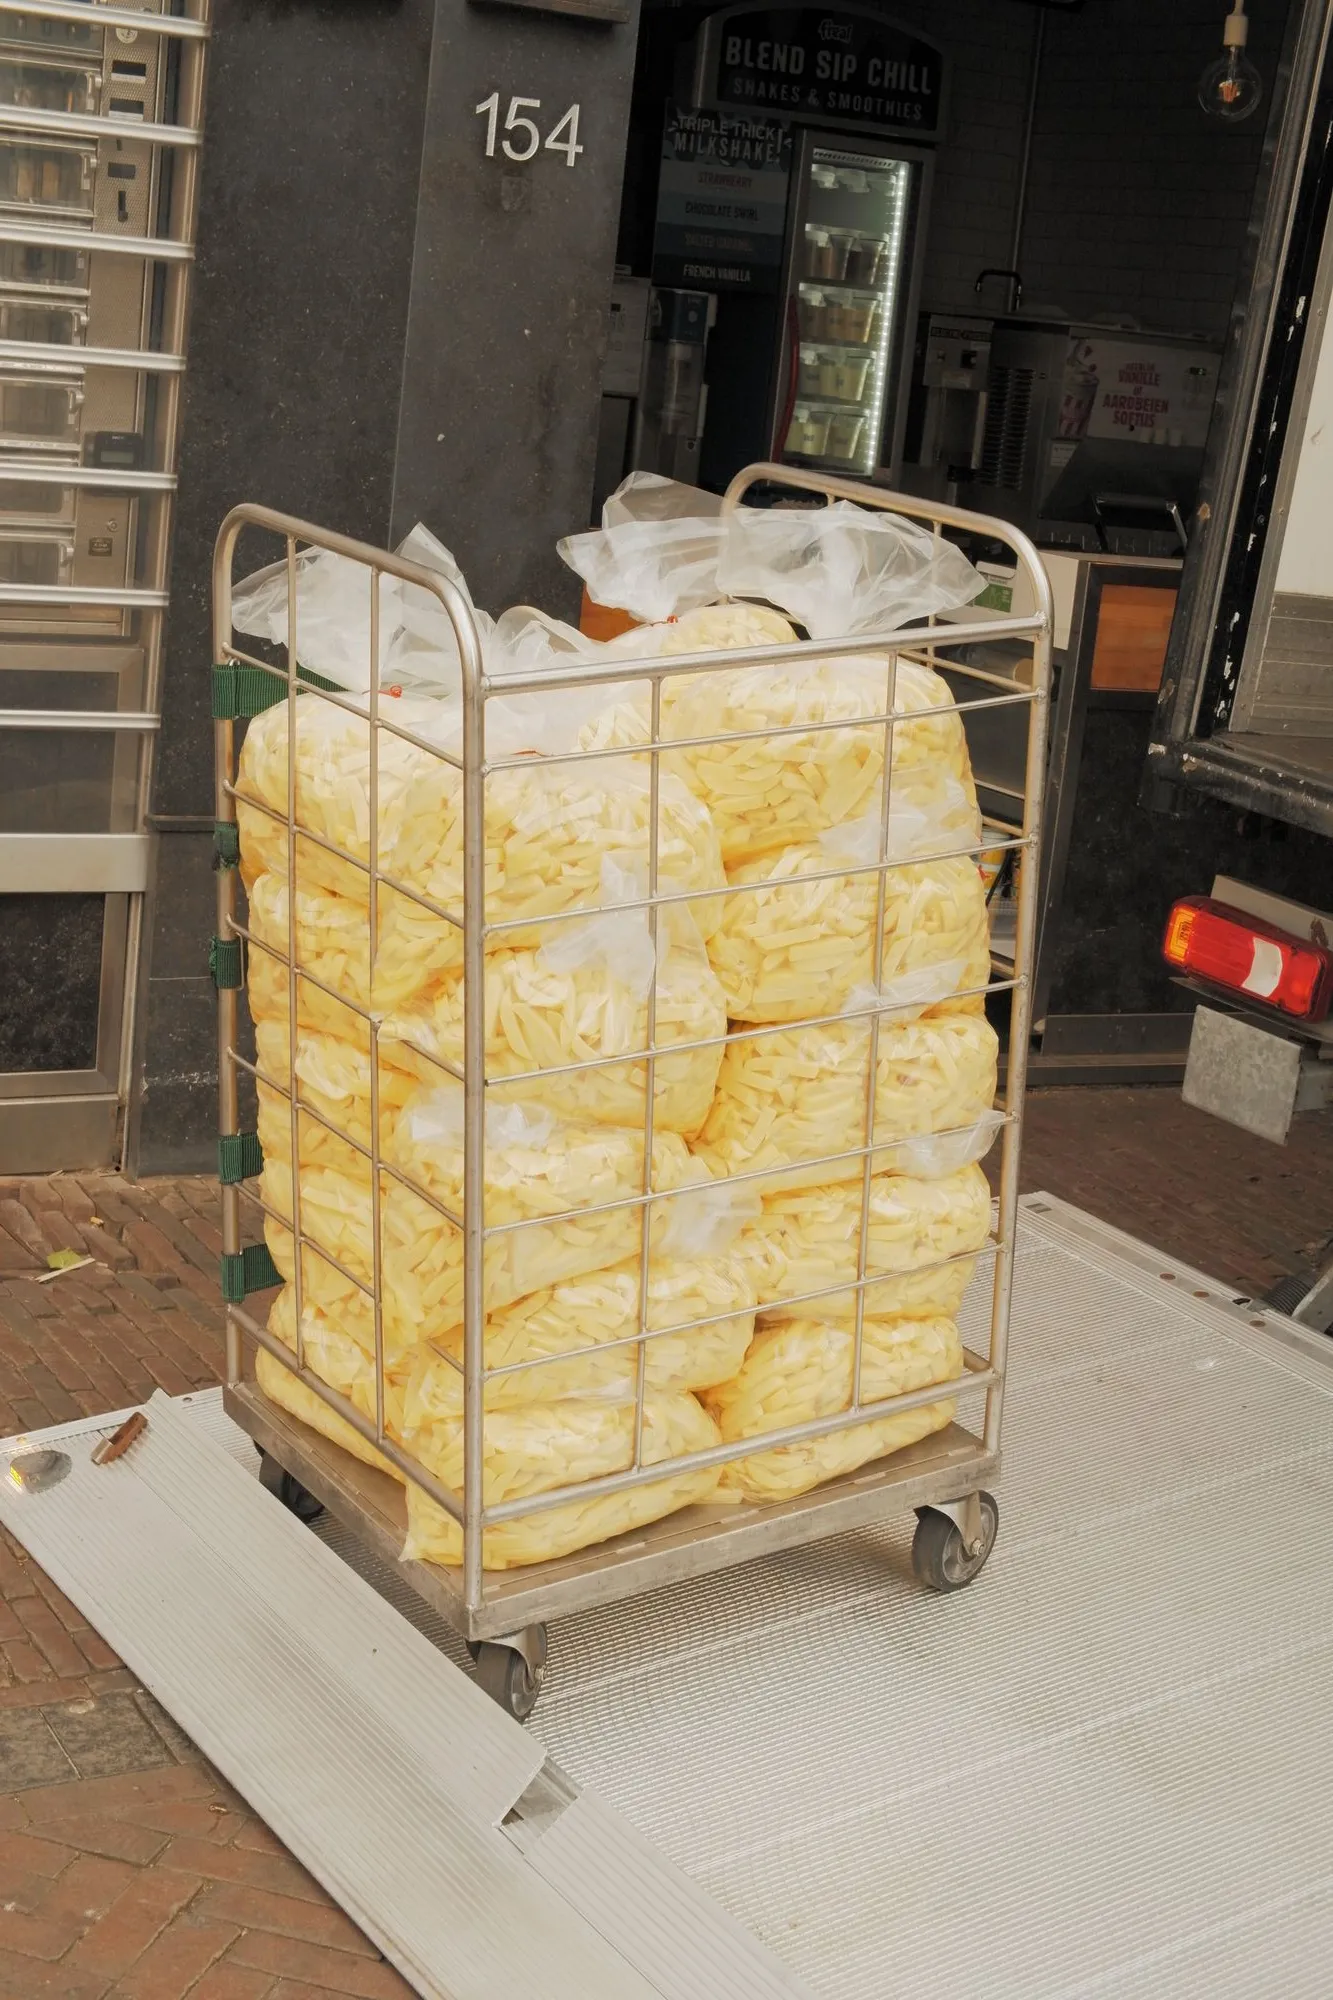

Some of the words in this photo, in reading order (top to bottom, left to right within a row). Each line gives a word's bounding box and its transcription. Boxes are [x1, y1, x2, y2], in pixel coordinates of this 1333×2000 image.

[725, 36, 805, 75] BLEND
[815, 50, 858, 81] SIP
[867, 57, 932, 94] CHILL
[733, 77, 801, 103] SHAKES
[807, 88, 820, 107] &
[827, 90, 923, 121] SMOOTHIES
[475, 92, 584, 167] 154
[677, 115, 729, 136] TRIPLE
[697, 170, 753, 189] STRAWBERRY
[684, 201, 732, 218] CHOCOLATE
[733, 206, 761, 222] SWIRL
[683, 264, 716, 279] FRENCH
[717, 268, 751, 283] VANILLA
[1118, 370, 1161, 387] VANILLE
[1102, 393, 1169, 414] AARDBEIEN
